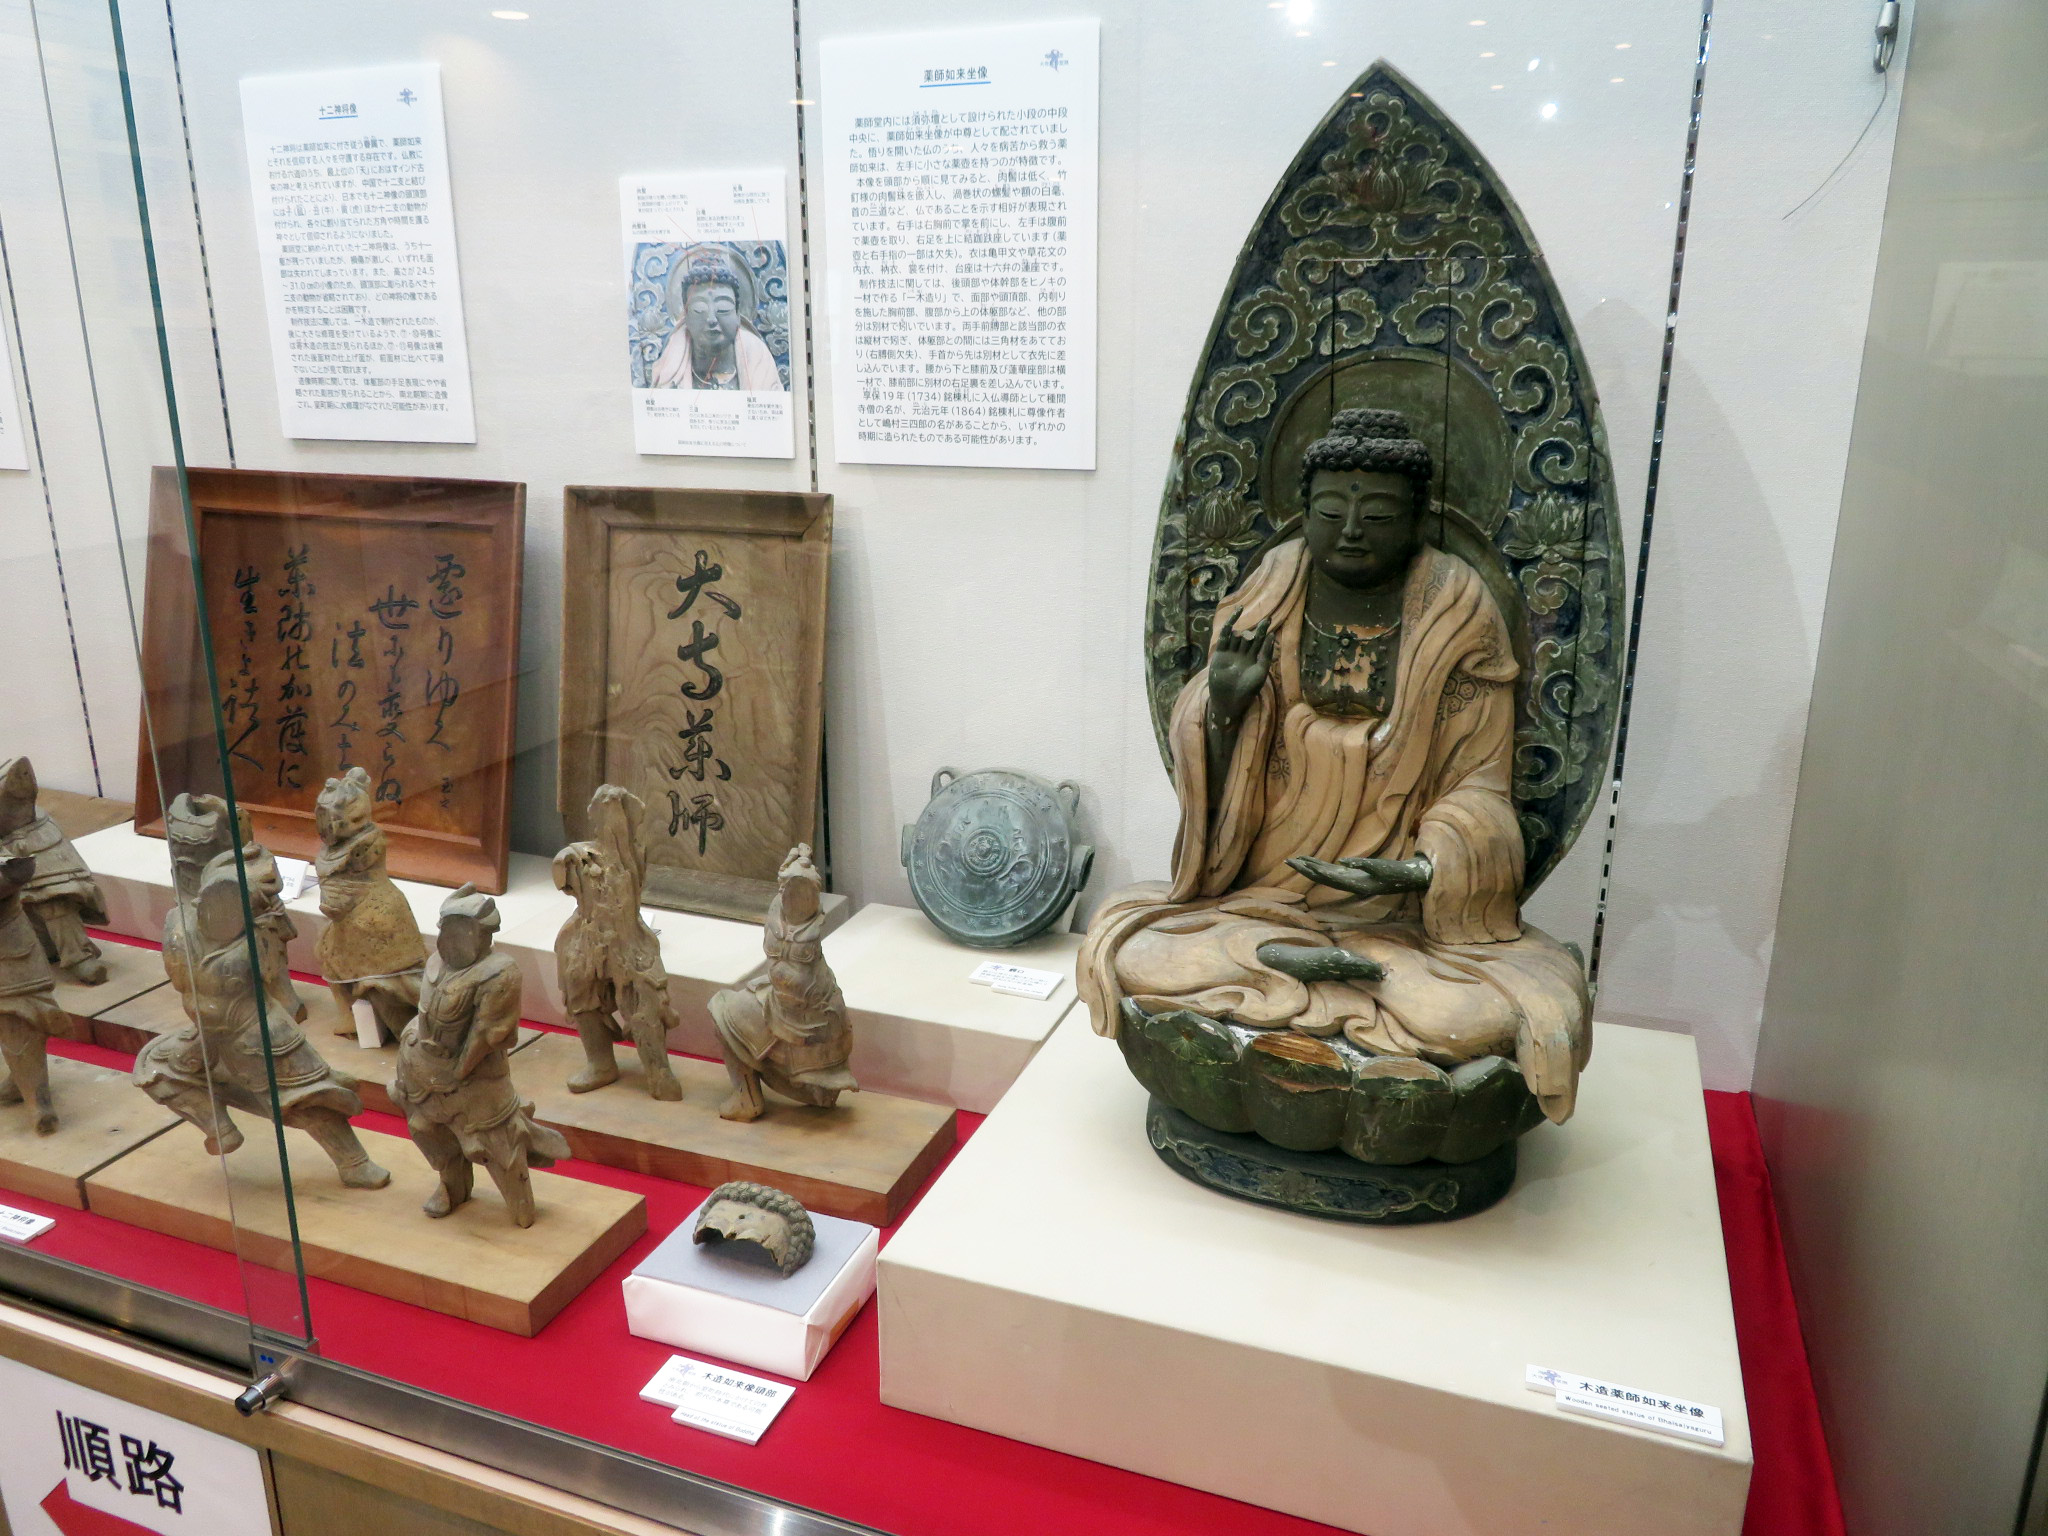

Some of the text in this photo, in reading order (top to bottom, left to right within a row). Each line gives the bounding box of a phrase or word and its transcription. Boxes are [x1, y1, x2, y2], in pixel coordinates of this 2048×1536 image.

[923, 66, 988, 83] 薬師如来坐像
[702, 1372, 777, 1398] 木造如来像頭部
[1564, 1395, 1593, 1407] Wooden
[1595, 1402, 1620, 1413] seated
[1621, 1408, 1646, 1419] statue
[1579, 1381, 1706, 1419] 木造薬師如来坐像
[56, 1409, 185, 1515] 順路
